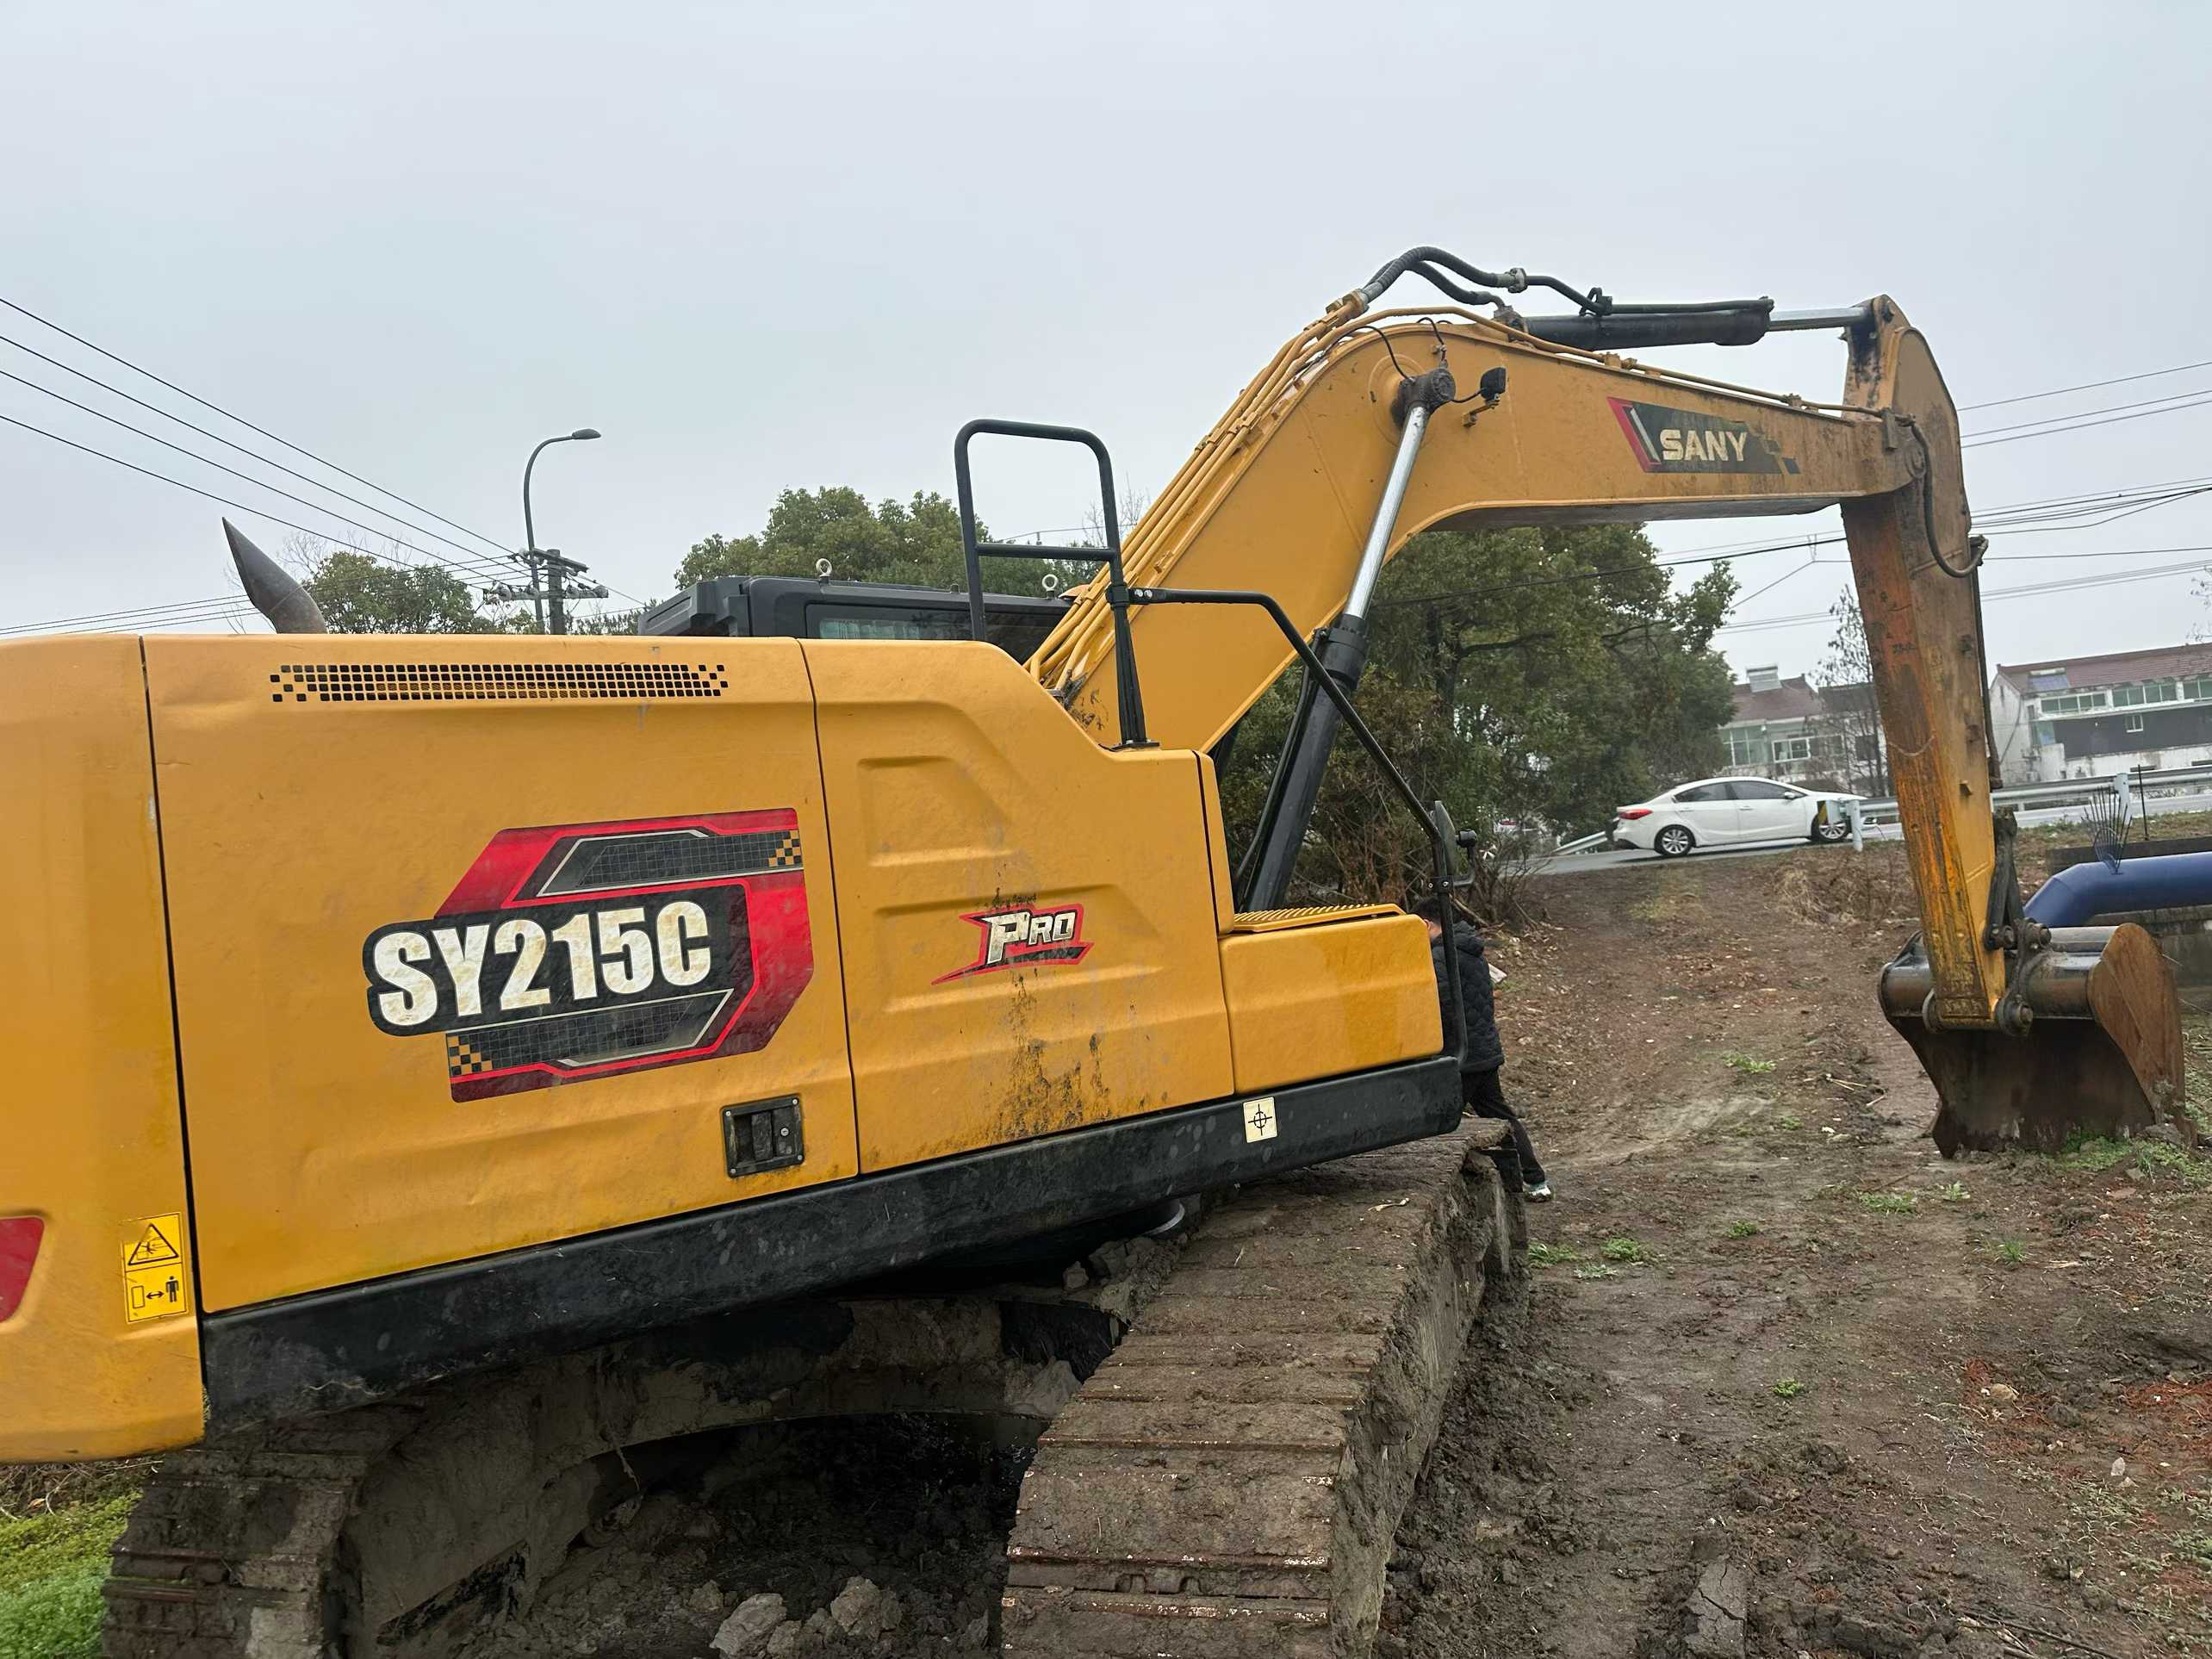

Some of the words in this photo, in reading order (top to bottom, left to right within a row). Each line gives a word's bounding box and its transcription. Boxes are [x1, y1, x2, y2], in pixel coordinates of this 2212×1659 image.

[1660, 429, 1748, 461] SANY
[373, 901, 711, 1026] SY215C
[981, 909, 1076, 965] PRO
